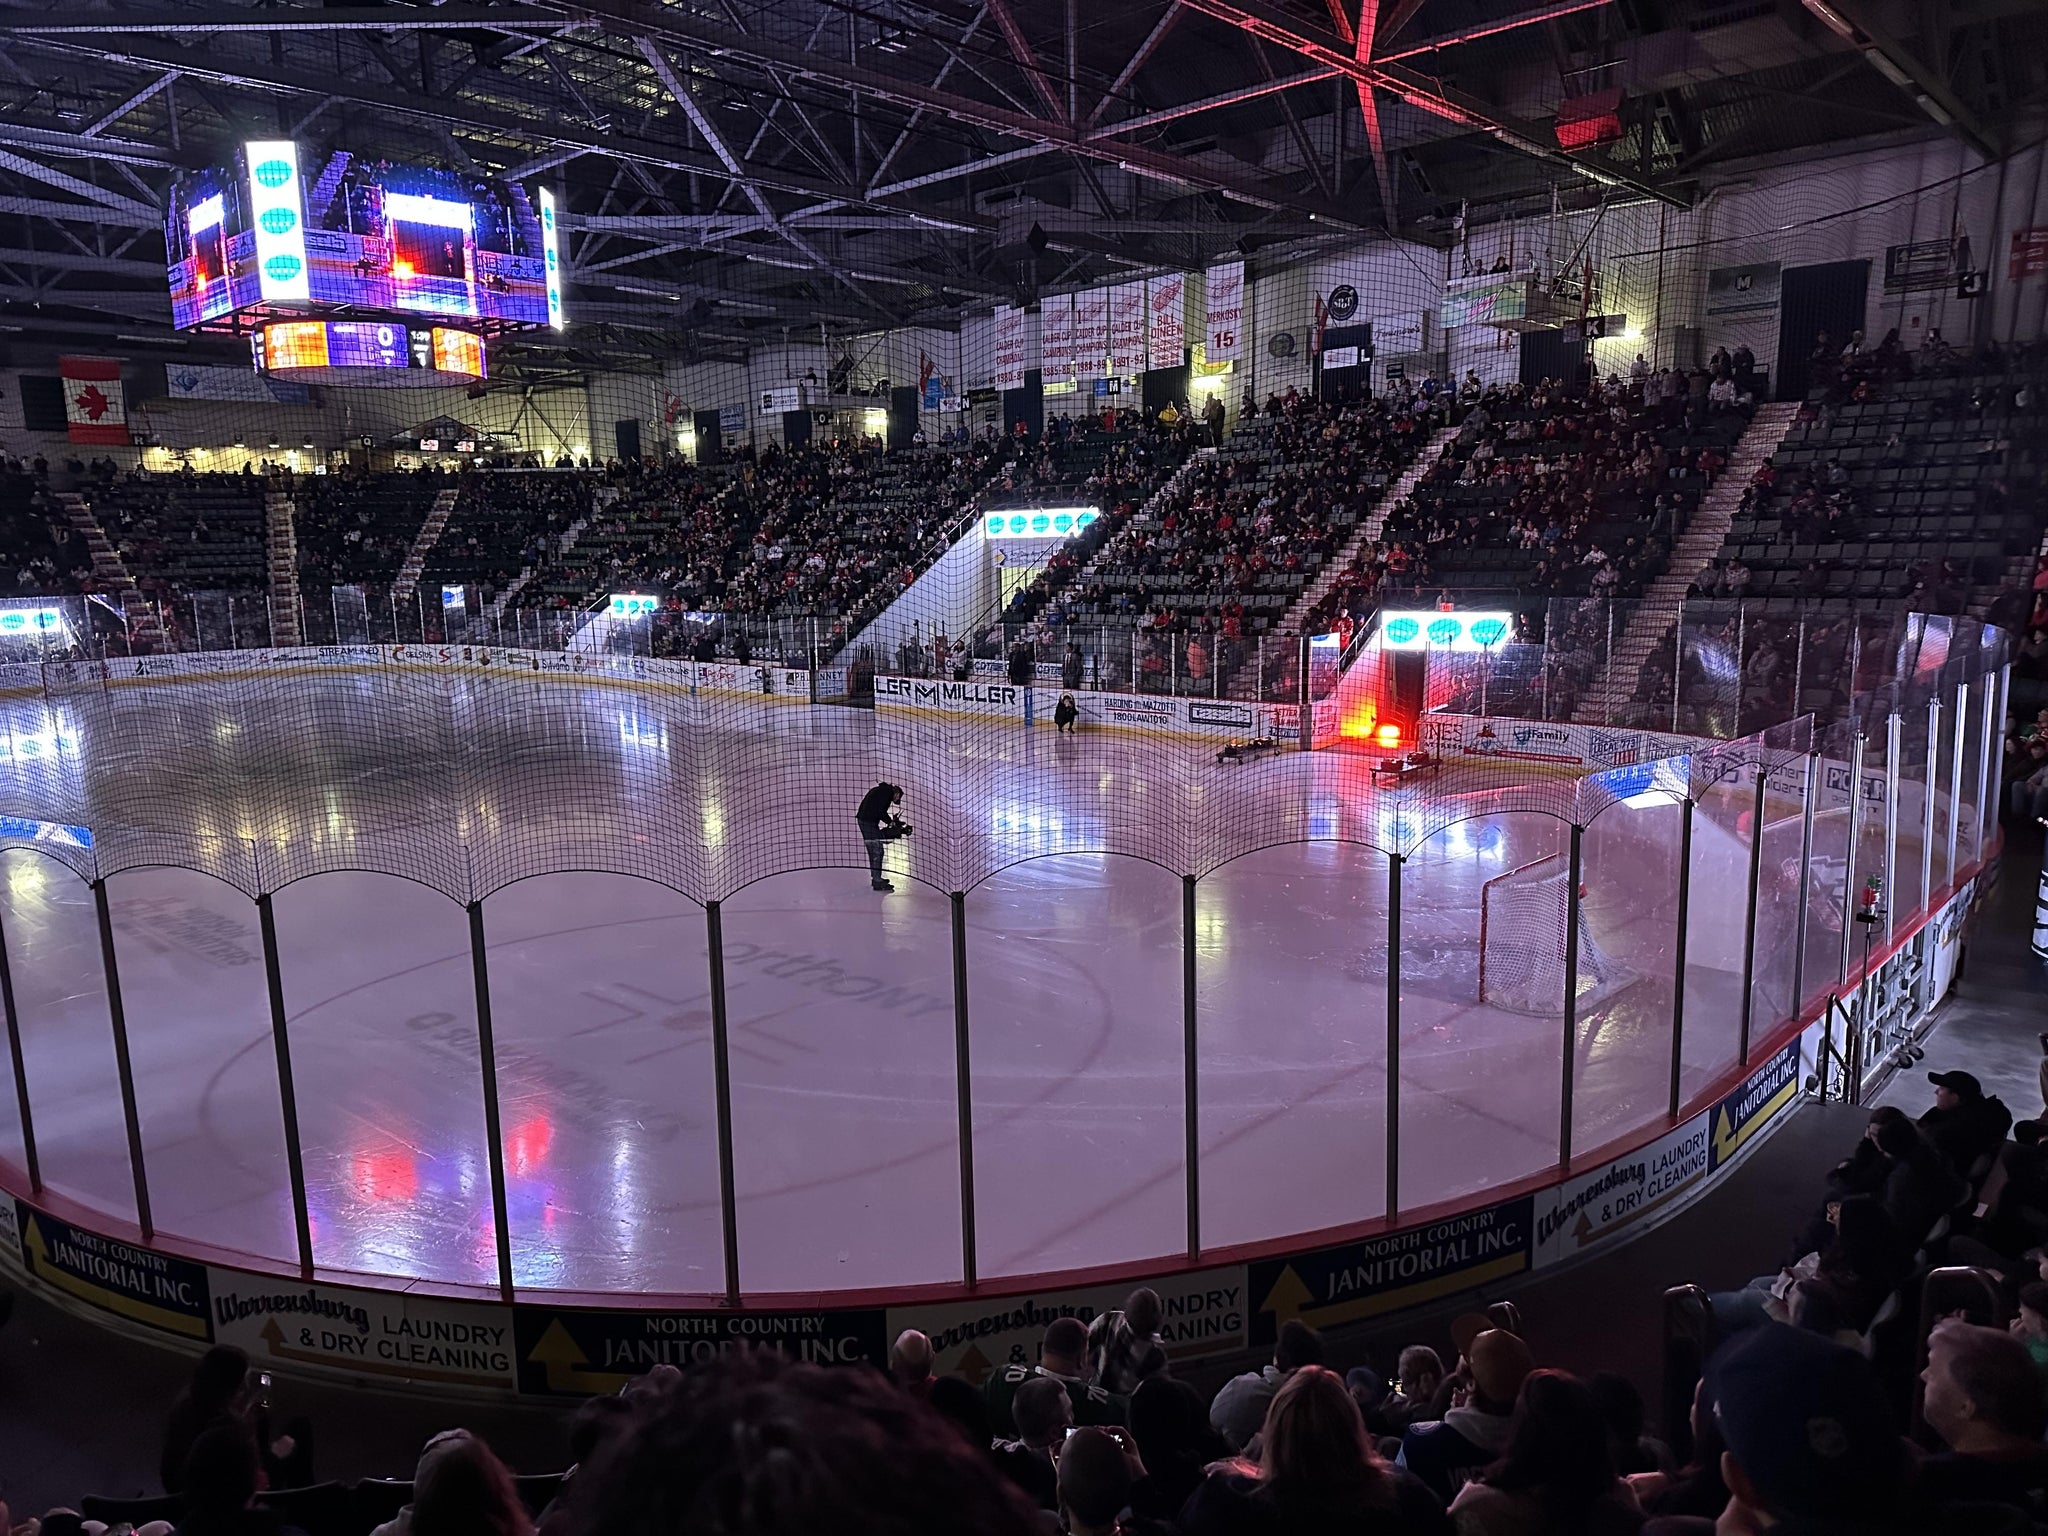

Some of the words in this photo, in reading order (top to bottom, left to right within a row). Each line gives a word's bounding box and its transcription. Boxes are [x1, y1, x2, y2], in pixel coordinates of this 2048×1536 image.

[304, 234, 346, 250] sella
[1157, 313, 1176, 327] BILL
[1207, 308, 1242, 323] MERKOSKY
[1075, 328, 1096, 339] CALDER
[1096, 326, 1107, 338] CUP
[1112, 322, 1132, 335] CALDER
[1133, 320, 1145, 330] CUP
[1151, 324, 1183, 339] DINEEN
[1586, 321, 1600, 336] K
[378, 327, 394, 347] 0
[1042, 332, 1061, 344] CALDER
[1061, 331, 1071, 342] CUP
[1112, 336, 1145, 350] CHAMPIONS
[1214, 331, 1234, 349] 15
[996, 339, 1014, 351] CALDER
[1075, 342, 1108, 355] CHAMPIONS
[996, 353, 1024, 366] CHAMPIONS
[1042, 347, 1072, 360] CHAMPIONS
[1113, 354, 1144, 368] 1991-92
[1361, 349, 1370, 362] L
[1043, 364, 1071, 377] 1985-86
[1077, 360, 1106, 372] 1988-89
[1109, 380, 1119, 393] M
[963, 397, 970, 409] N
[542, 658, 570, 673] Sylvamo
[943, 684, 1016, 706] MILLER
[1104, 697, 1133, 709] HARDING
[1142, 700, 1176, 712] MAZZOTTI
[1113, 712, 1168, 725] 1800LAW1010
[1532, 729, 1570, 744] Family
[1593, 742, 1618, 754] LOCAL
[1749, 771, 1806, 796] Bilders
[1747, 1066, 1765, 1092] NORTH
[1765, 1047, 1789, 1076] COUNTRY
[1734, 1074, 1779, 1130] JANITORIAL
[1780, 1055, 1796, 1084] INC.
[1537, 1159, 1647, 1247] Warrensburg
[1652, 1128, 1707, 1176] LAUNDRY
[1600, 1204, 1612, 1223] &
[1616, 1187, 1644, 1217] DRY
[1647, 1150, 1706, 1199] CLEANING
[1364, 1233, 1421, 1259] NORTH
[1427, 1211, 1497, 1243] COUNTRY
[69, 1229, 107, 1255] NORTH
[111, 1244, 169, 1273] COUNTRY
[1327, 1238, 1471, 1300] JANITORIAL
[1477, 1222, 1522, 1256] INC.
[53, 1238, 151, 1294] JANITORIAL
[155, 1276, 199, 1308] INC.
[214, 1289, 370, 1333] Warrensburg
[383, 1315, 507, 1347] LAUNDRY
[646, 1317, 718, 1334] NORTH
[727, 1317, 825, 1334] COUNTRY
[918, 1300, 1095, 1352] arrensburg
[1009, 1343, 1028, 1364] &
[1160, 1312, 1242, 1343] ANING
[300, 1328, 315, 1348] &
[321, 1331, 369, 1356] DRY
[377, 1340, 510, 1372] CLEANING
[800, 1337, 869, 1362] INC.
